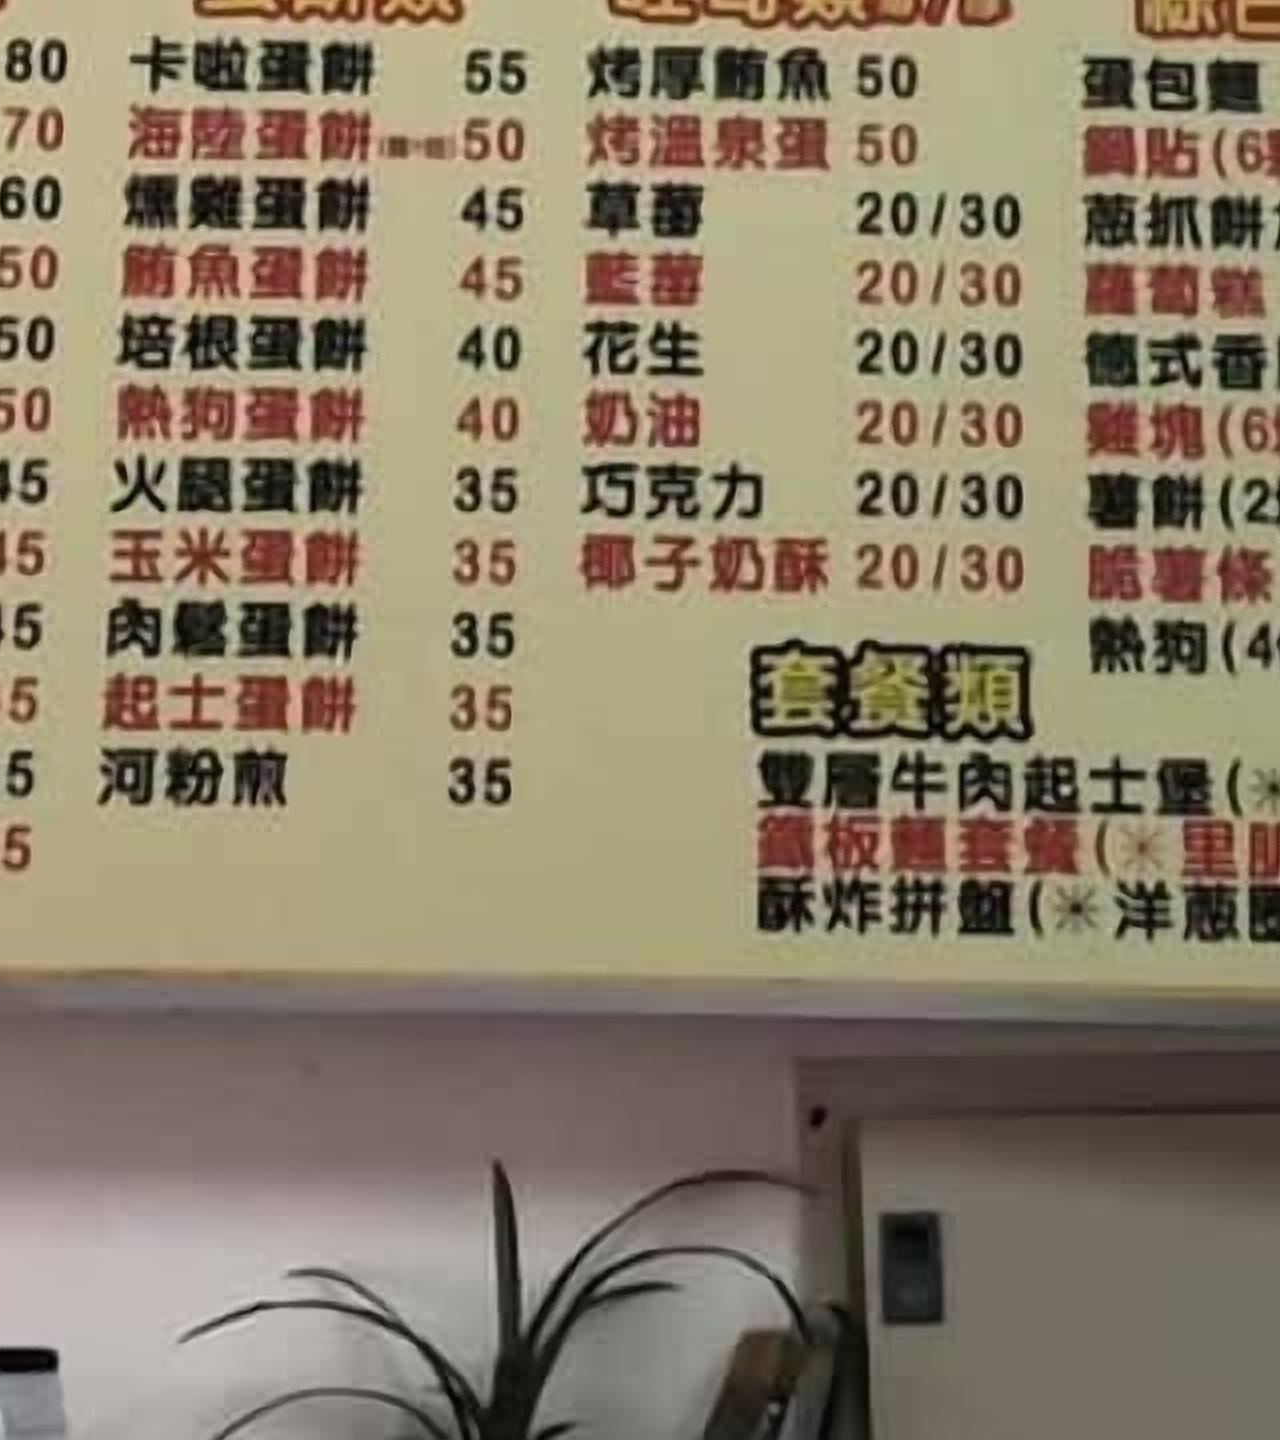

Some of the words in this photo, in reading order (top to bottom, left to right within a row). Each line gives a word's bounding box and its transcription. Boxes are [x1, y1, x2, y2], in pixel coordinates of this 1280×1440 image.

[5, 38, 67, 84] 80
[129, 35, 375, 96] 卡啦蛋餅
[465, 49, 527, 95] 55
[857, 54, 918, 99] 50
[4, 107, 64, 151] 70
[464, 118, 524, 162] 50
[586, 112, 830, 171] 烤溫泉蛋
[857, 124, 917, 166] 50
[461, 186, 524, 232] 45
[585, 179, 704, 239] 草莓
[856, 191, 1021, 239] 20/30
[121, 241, 368, 303] 鮪魚蛋餅
[459, 256, 522, 301] 45
[857, 260, 1021, 307] 20/30
[116, 312, 368, 373] 培根蛋餅
[457, 325, 522, 371] 40
[582, 319, 704, 378] 花生
[856, 329, 1022, 378] 20/30
[118, 383, 365, 443] 熱狗蛋餅
[457, 397, 519, 441] 40
[583, 389, 700, 448] 奶油
[857, 400, 1023, 448] 20/30
[110, 454, 363, 515] 火腿蛋餅
[454, 466, 518, 514] 35
[580, 462, 763, 521] 巧克力
[856, 470, 1023, 520] 20/30
[109, 527, 360, 587] 玉米蛋餅
[453, 539, 516, 586] 35
[579, 534, 829, 594] 椰子奶酥
[856, 544, 1023, 592] 20/30
[106, 597, 359, 662] 肉鬆蛋餅
[451, 612, 515, 659] 35
[102, 672, 356, 733] 起士蛋餅
[450, 685, 512, 731] 35
[749, 638, 1035, 744] 套餐類
[97, 746, 288, 807] 河粉煎
[448, 757, 511, 806] 35
